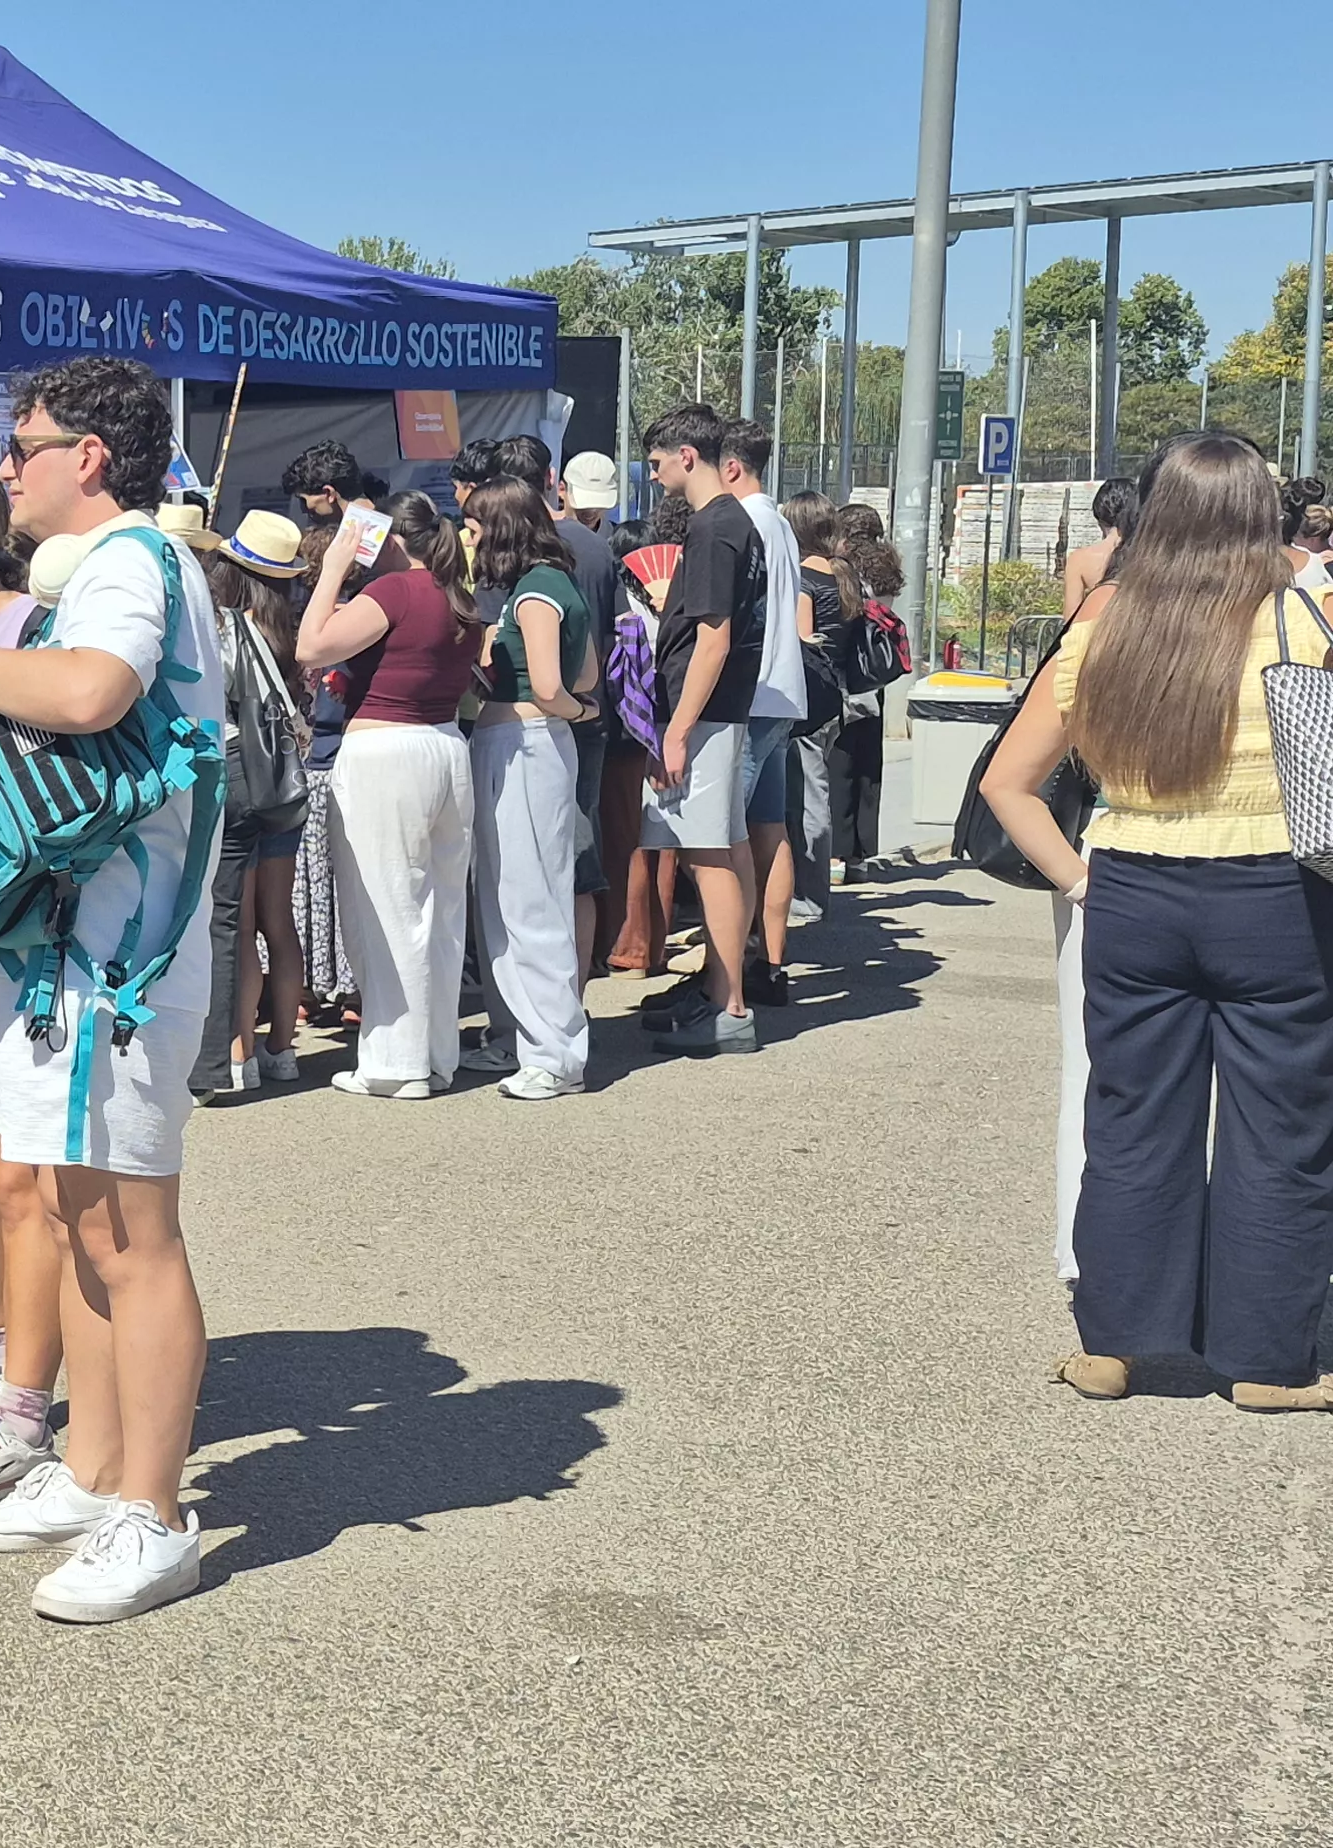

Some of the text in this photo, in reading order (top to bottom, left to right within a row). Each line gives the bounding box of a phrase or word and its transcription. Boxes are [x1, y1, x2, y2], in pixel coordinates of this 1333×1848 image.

[197, 303, 235, 355] DE
[239, 308, 401, 366] DESARROLLO
[405, 320, 544, 368] SOSTENIBLE
[988, 422, 1010, 469] P
